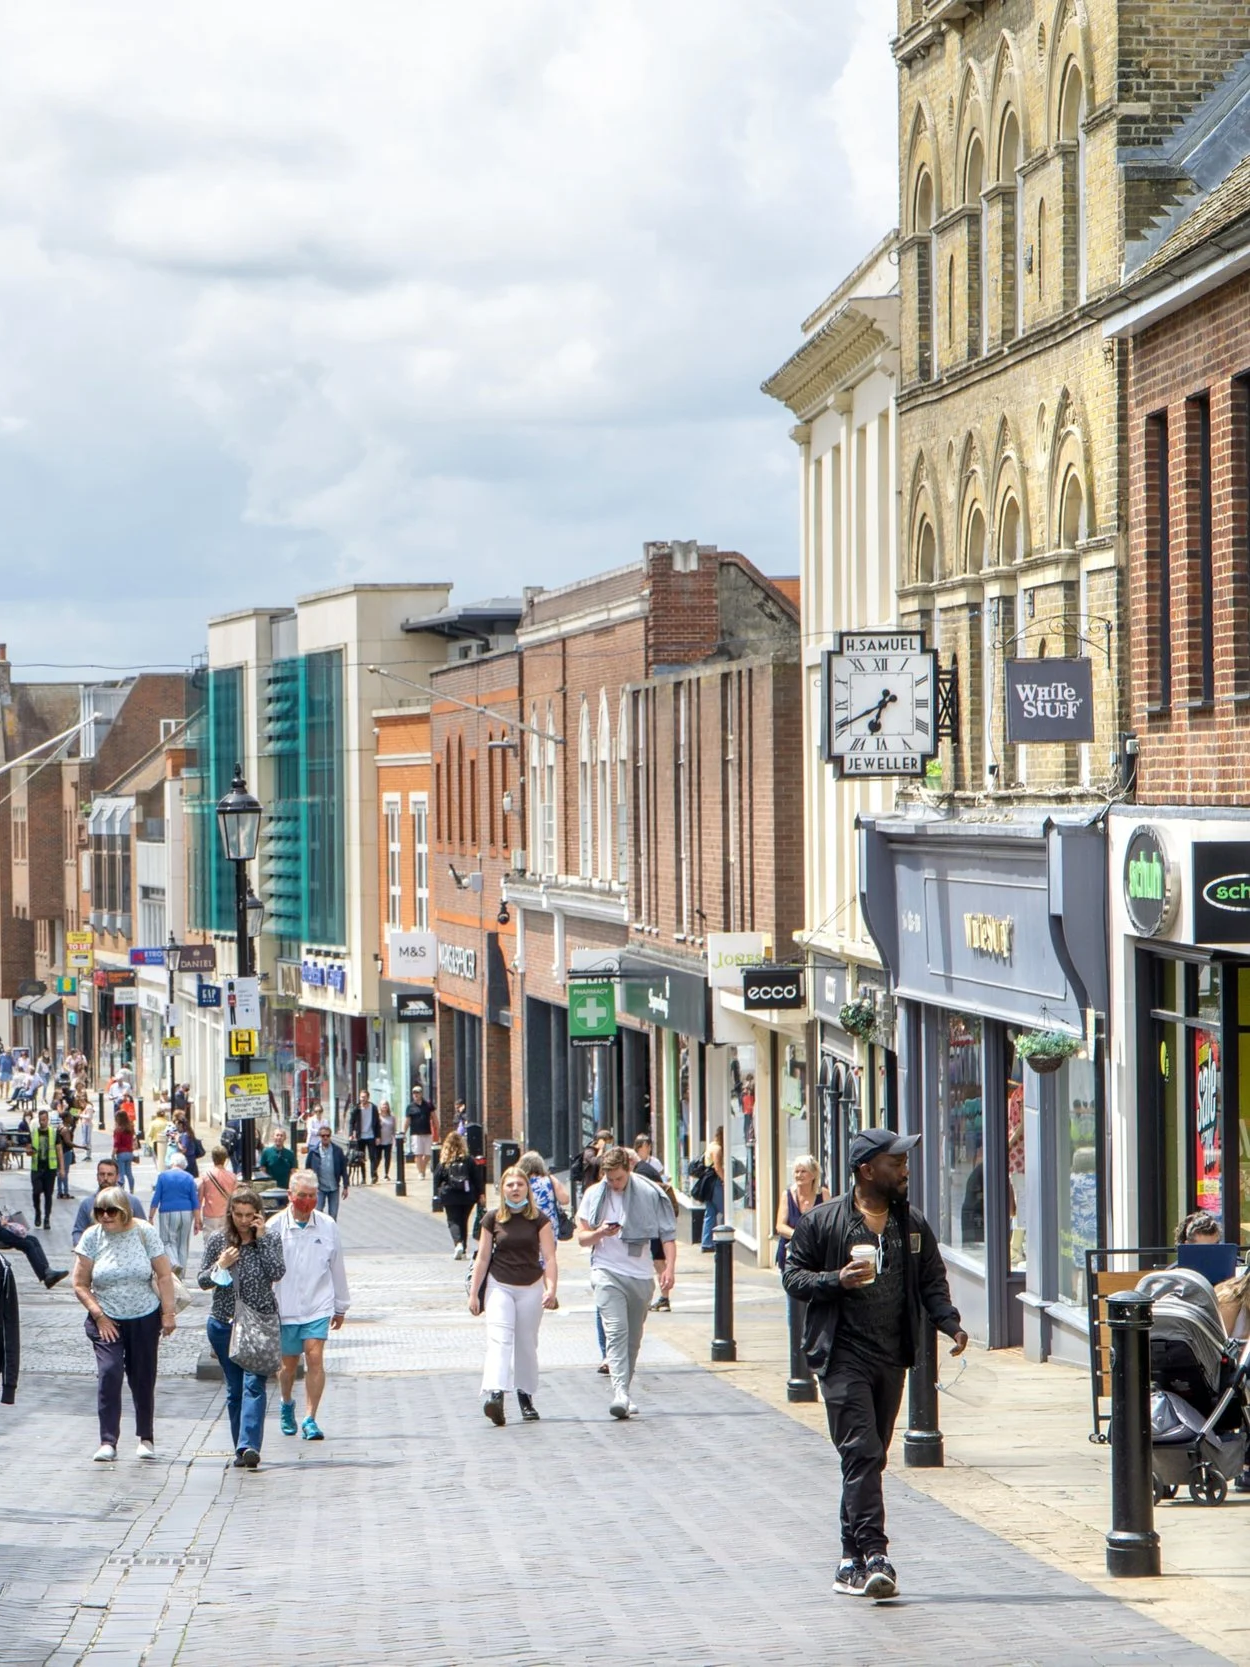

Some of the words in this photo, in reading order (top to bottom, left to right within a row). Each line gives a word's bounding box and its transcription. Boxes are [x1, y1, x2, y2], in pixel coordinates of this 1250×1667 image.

[873, 658, 889, 671] XII
[848, 757, 918, 771] JEWELLER
[1216, 883, 1250, 899] sch
[399, 946, 426, 958] M&S
[181, 960, 214, 968] DANIEL
[747, 985, 796, 1000] ecco
